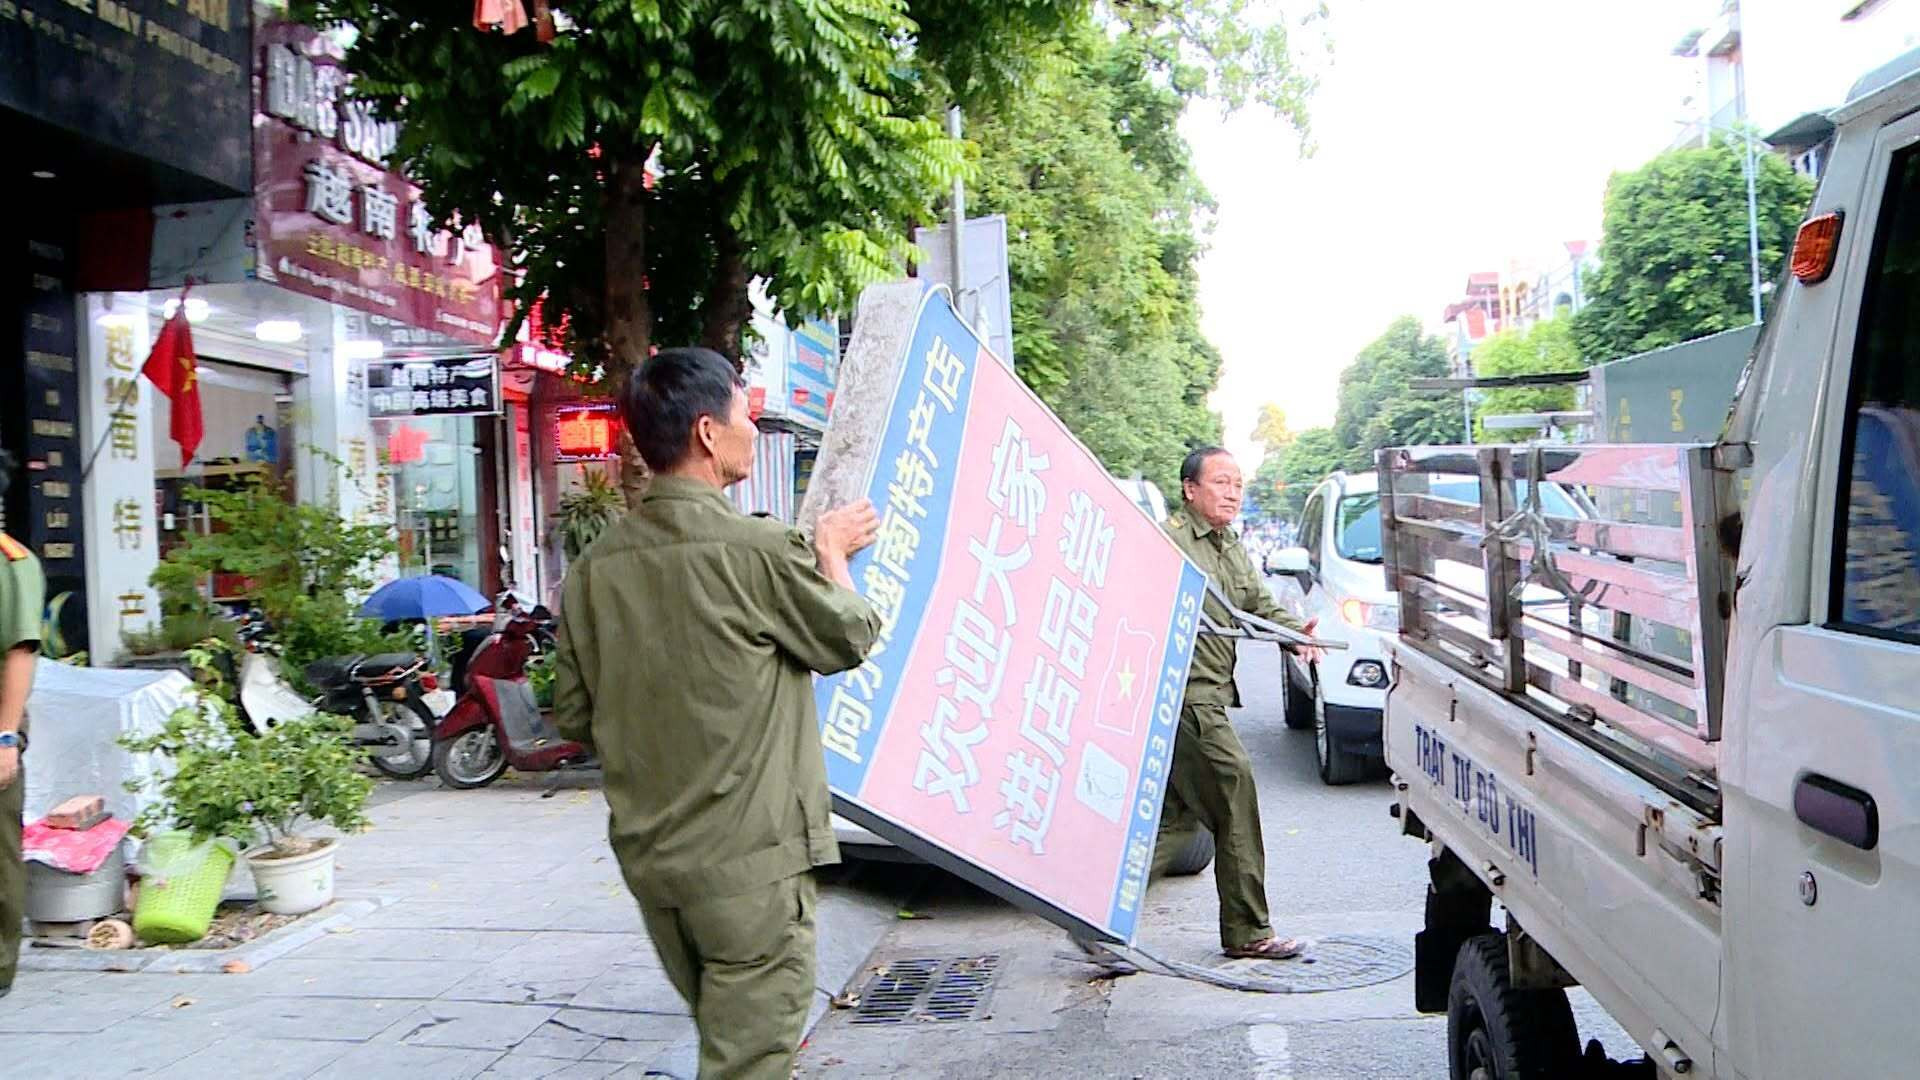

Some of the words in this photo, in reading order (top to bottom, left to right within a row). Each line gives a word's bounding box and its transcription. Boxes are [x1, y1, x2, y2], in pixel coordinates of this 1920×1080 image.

[911, 416, 1053, 814] 欢迎大家
[992, 488, 1117, 856] 进店品尝
[1138, 733, 1167, 822] 0333
[1158, 665, 1185, 727] 021
[1174, 591, 1197, 657] 455
[1415, 724, 1445, 786] TRẬT
[1452, 752, 1472, 815] TỰ
[1476, 770, 1500, 834] ĐÔ
[1505, 794, 1538, 879] THỊ
